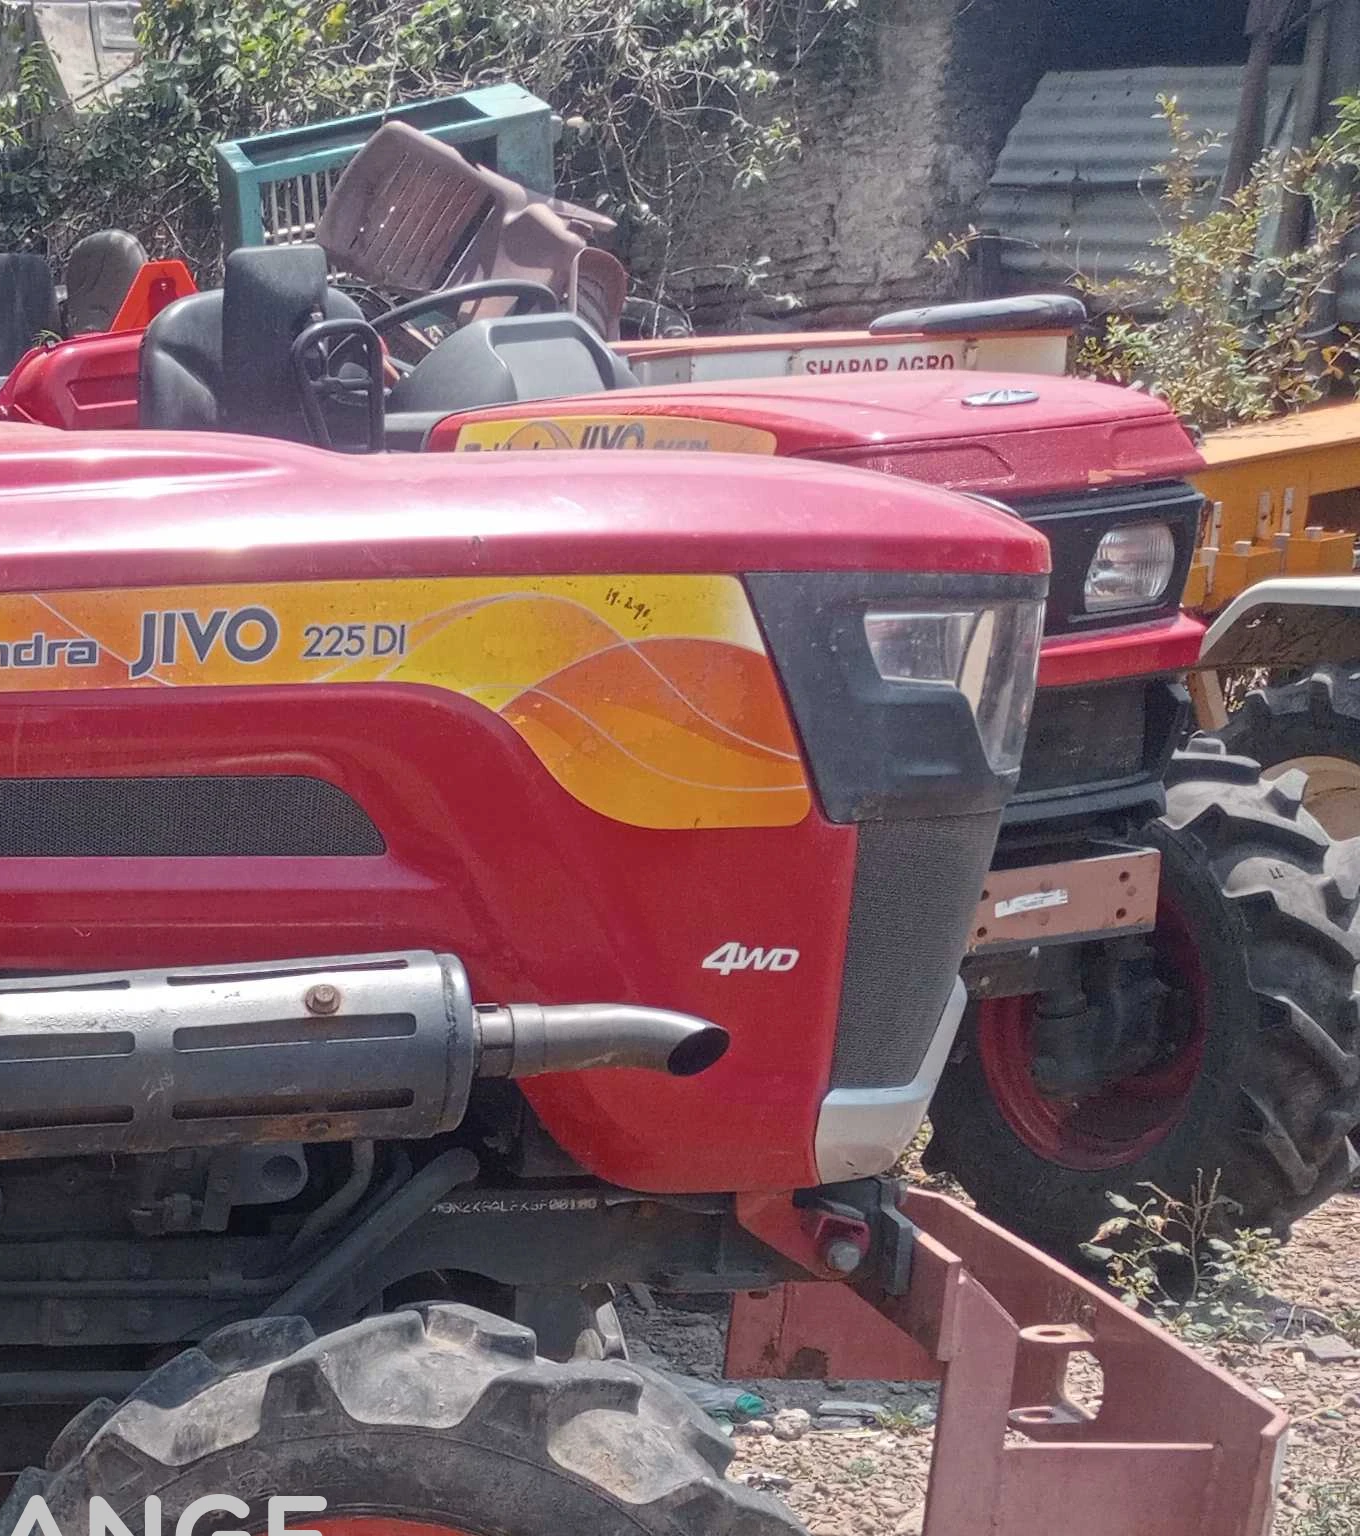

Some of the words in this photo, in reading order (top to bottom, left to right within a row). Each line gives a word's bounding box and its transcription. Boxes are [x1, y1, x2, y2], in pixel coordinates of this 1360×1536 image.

[128, 604, 280, 680] JIVO
[302, 622, 366, 659] 225
[372, 622, 408, 656] DI
[701, 941, 800, 976] 4WD
